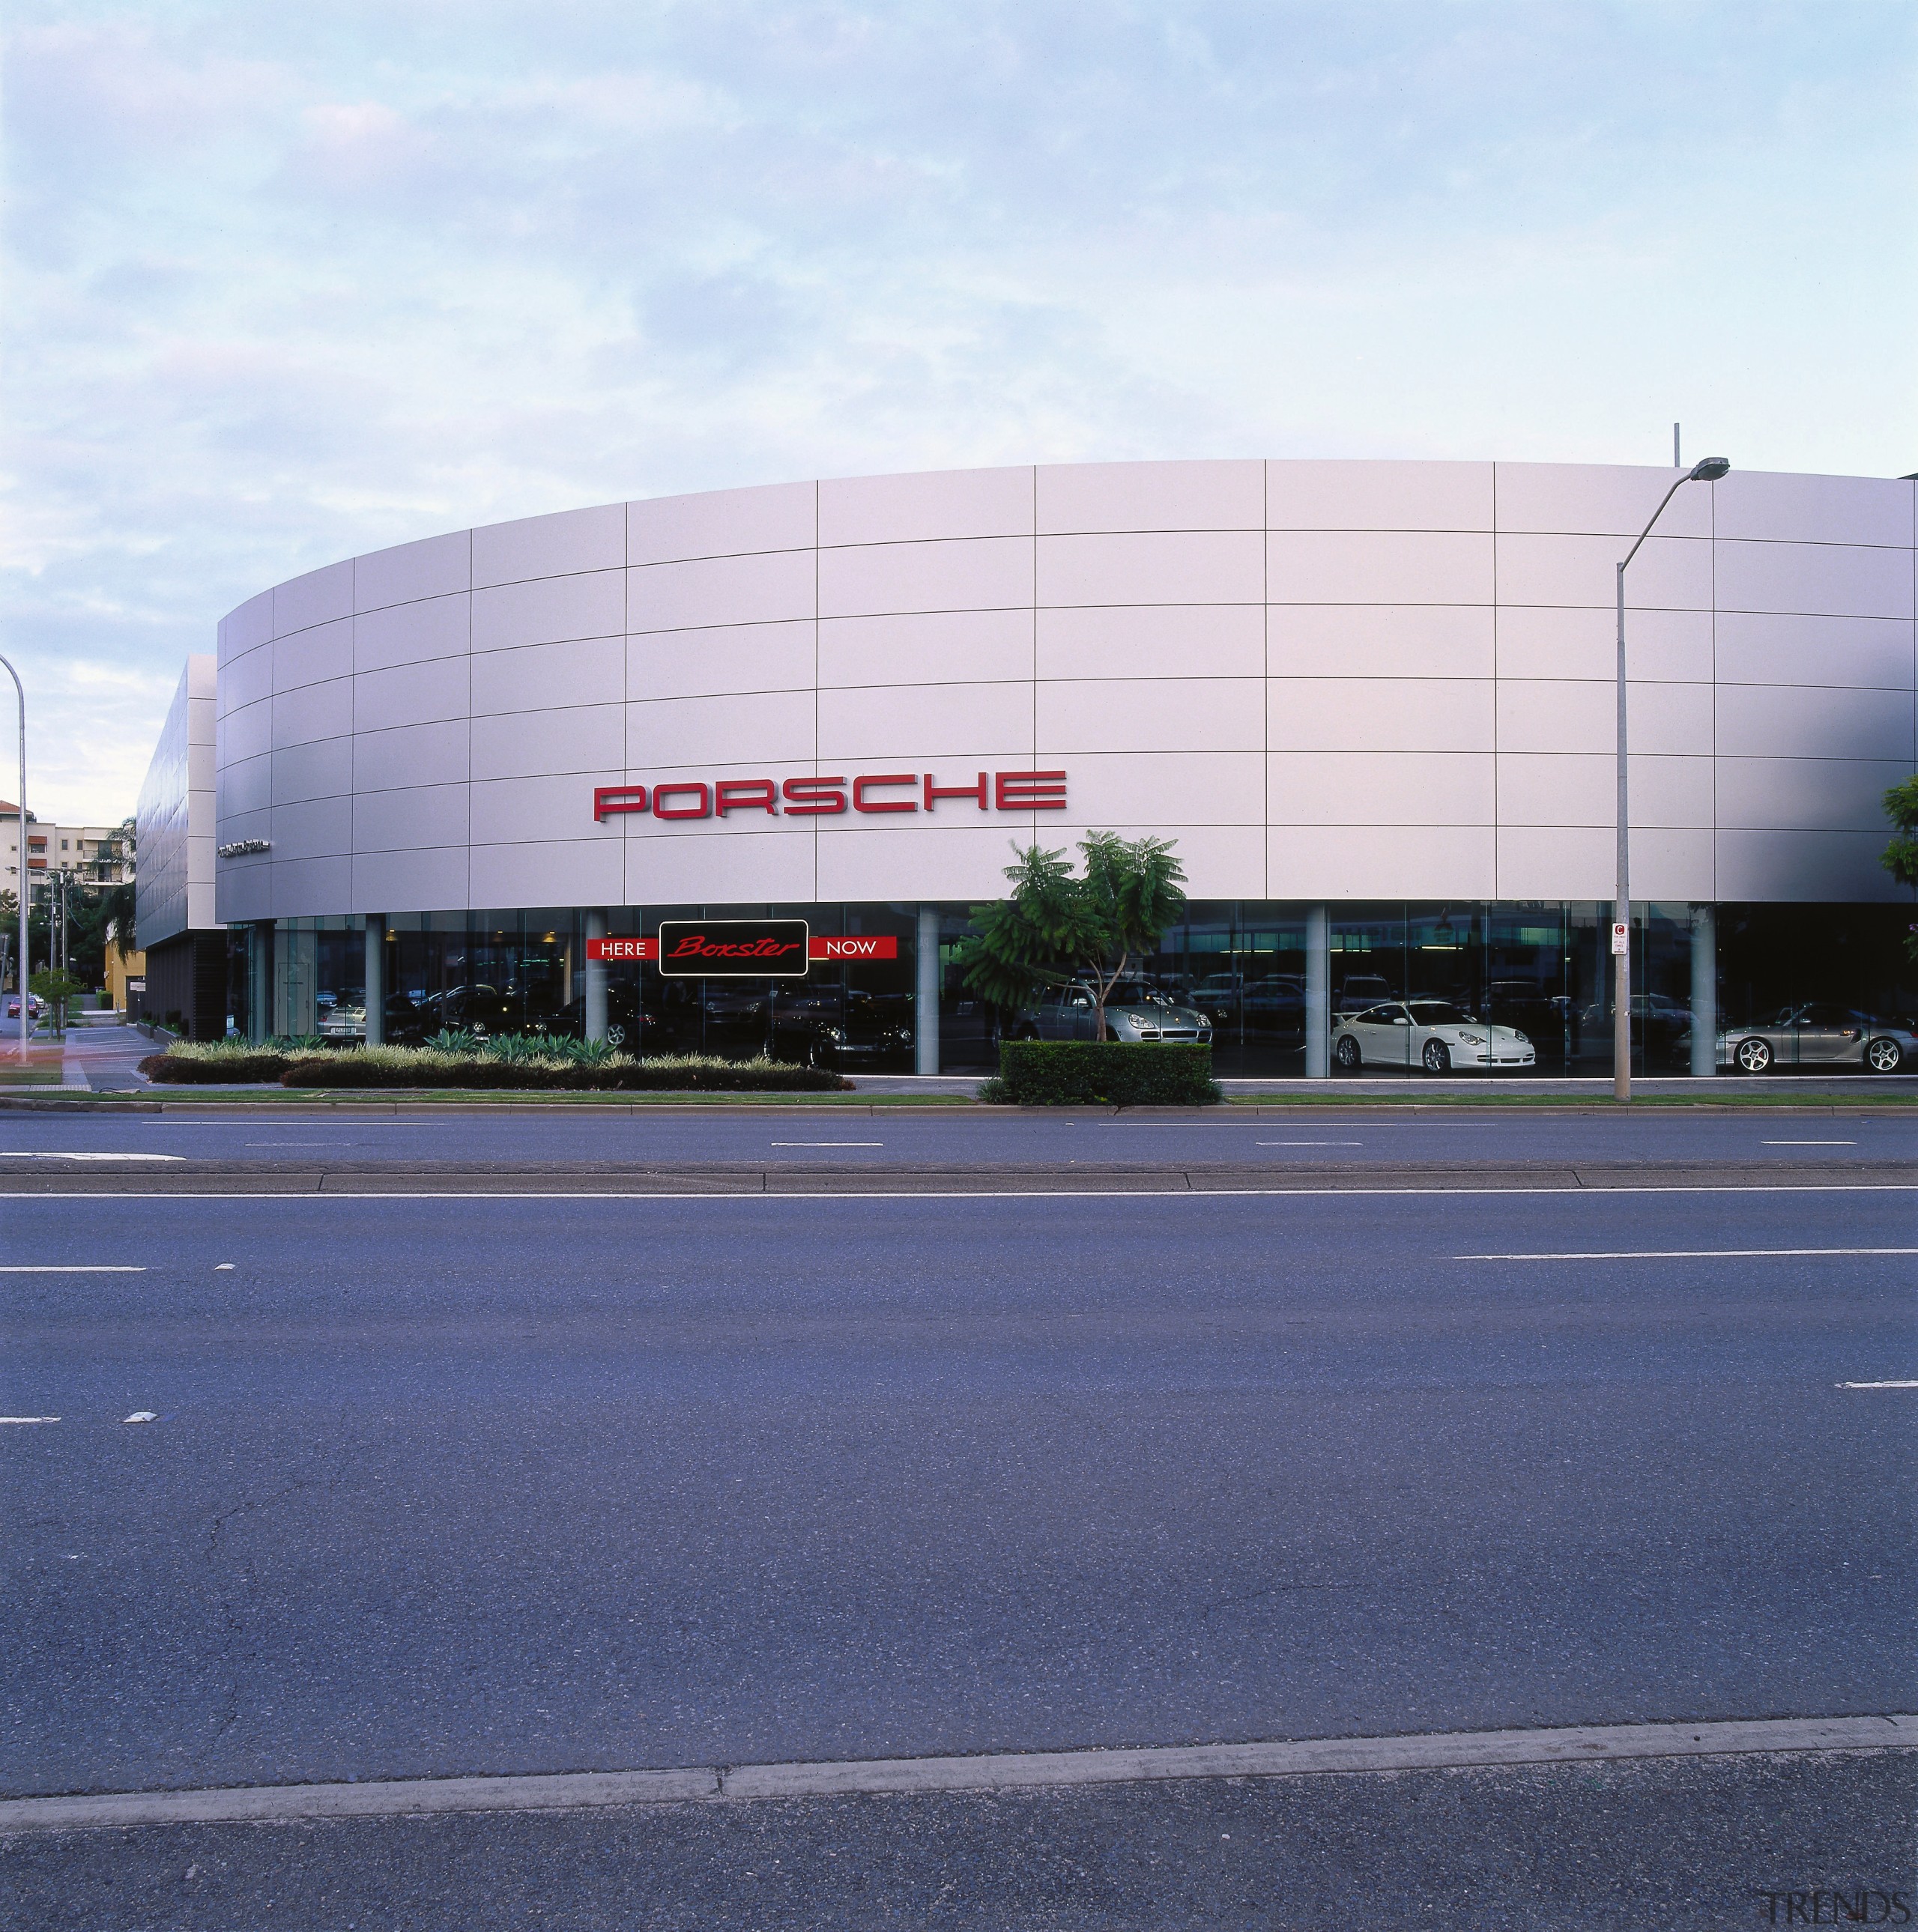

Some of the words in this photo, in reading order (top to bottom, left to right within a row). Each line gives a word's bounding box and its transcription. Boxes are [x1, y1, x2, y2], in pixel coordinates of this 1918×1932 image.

[593, 770, 1068, 823] PORSCHE
[601, 942, 646, 956] HERE
[667, 936, 800, 957] Boxster
[826, 940, 877, 955] NOW
